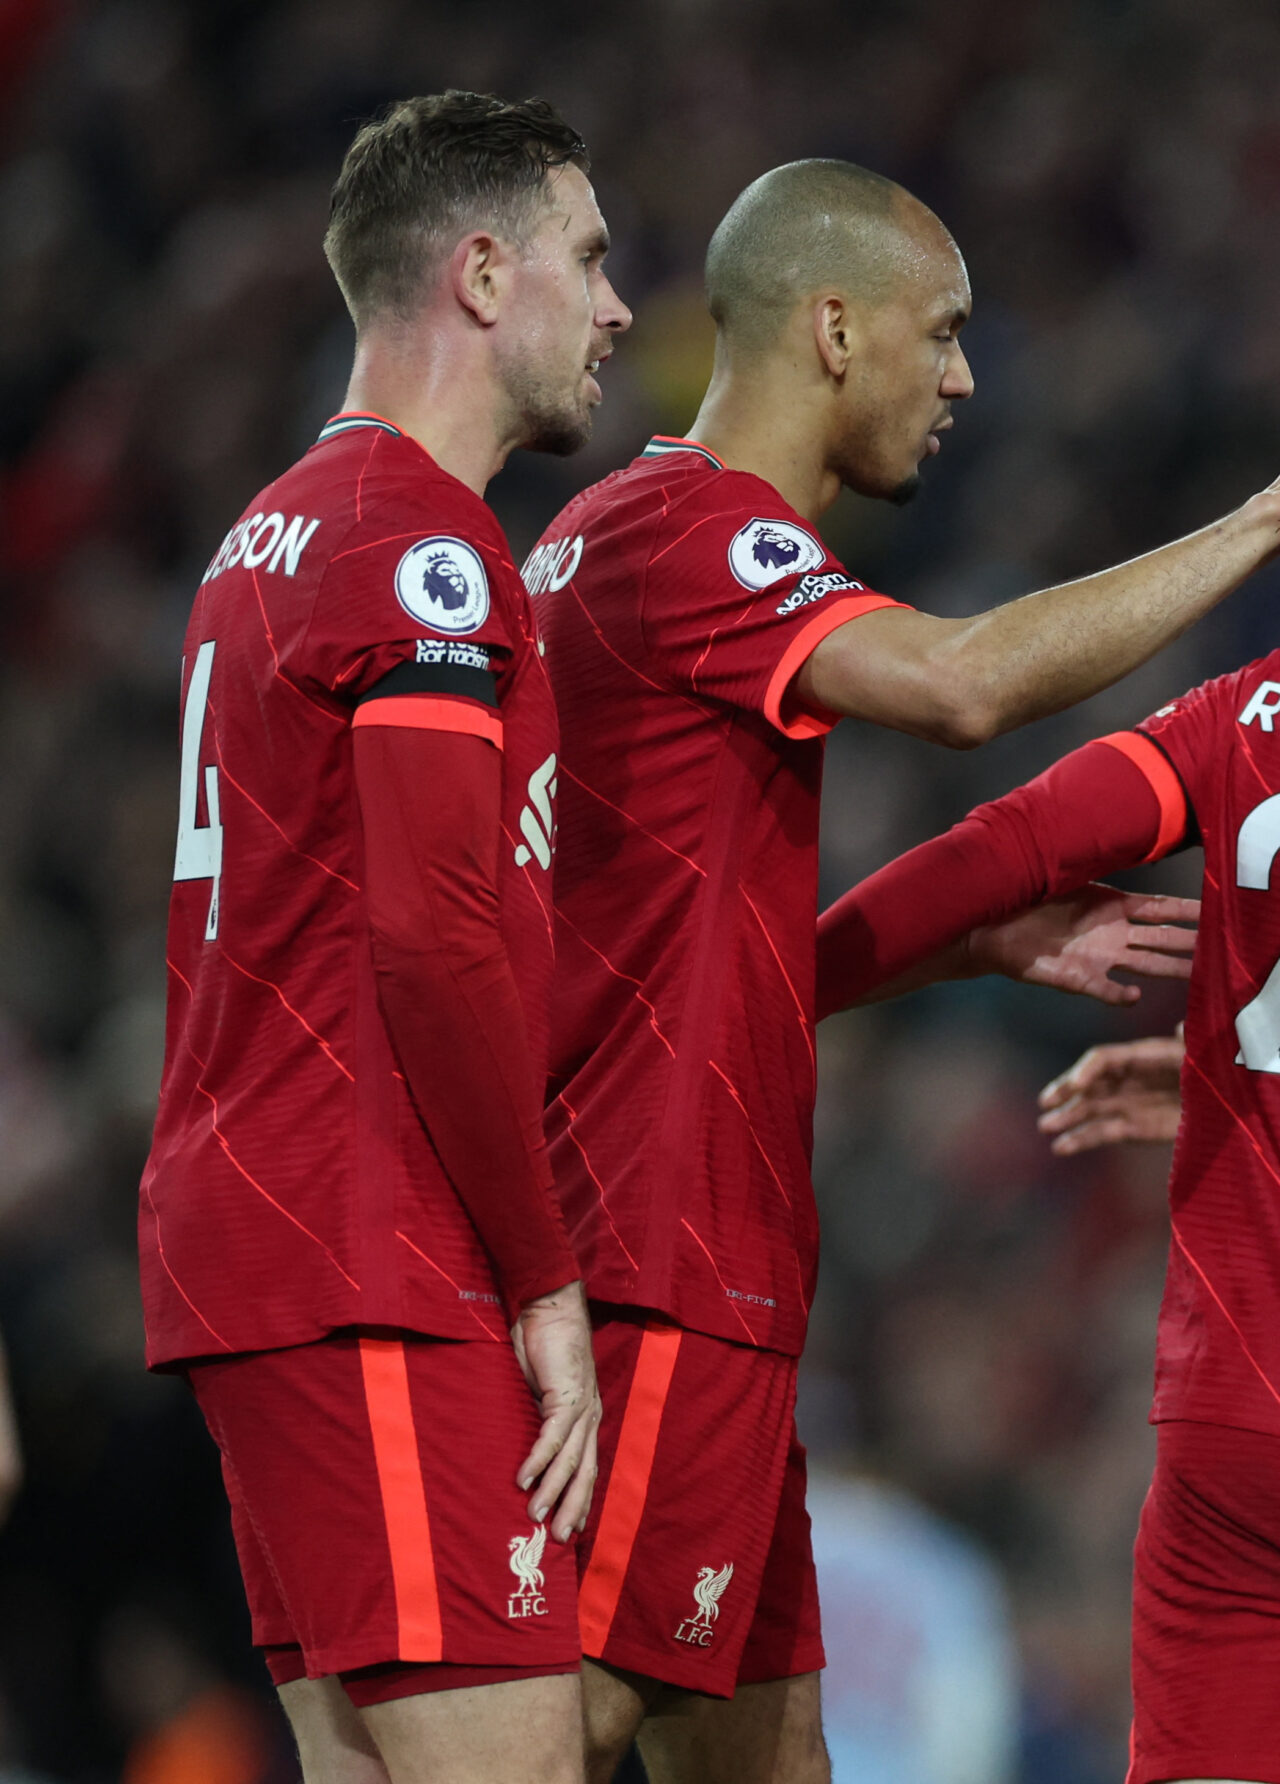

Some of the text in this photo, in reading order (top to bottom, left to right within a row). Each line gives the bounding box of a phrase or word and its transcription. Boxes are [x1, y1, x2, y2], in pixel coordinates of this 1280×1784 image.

[776, 592, 804, 615] No
[173, 639, 224, 942] 4
[508, 1597, 549, 1619] L.F.C.
[674, 1623, 714, 1647] L.F.C.
